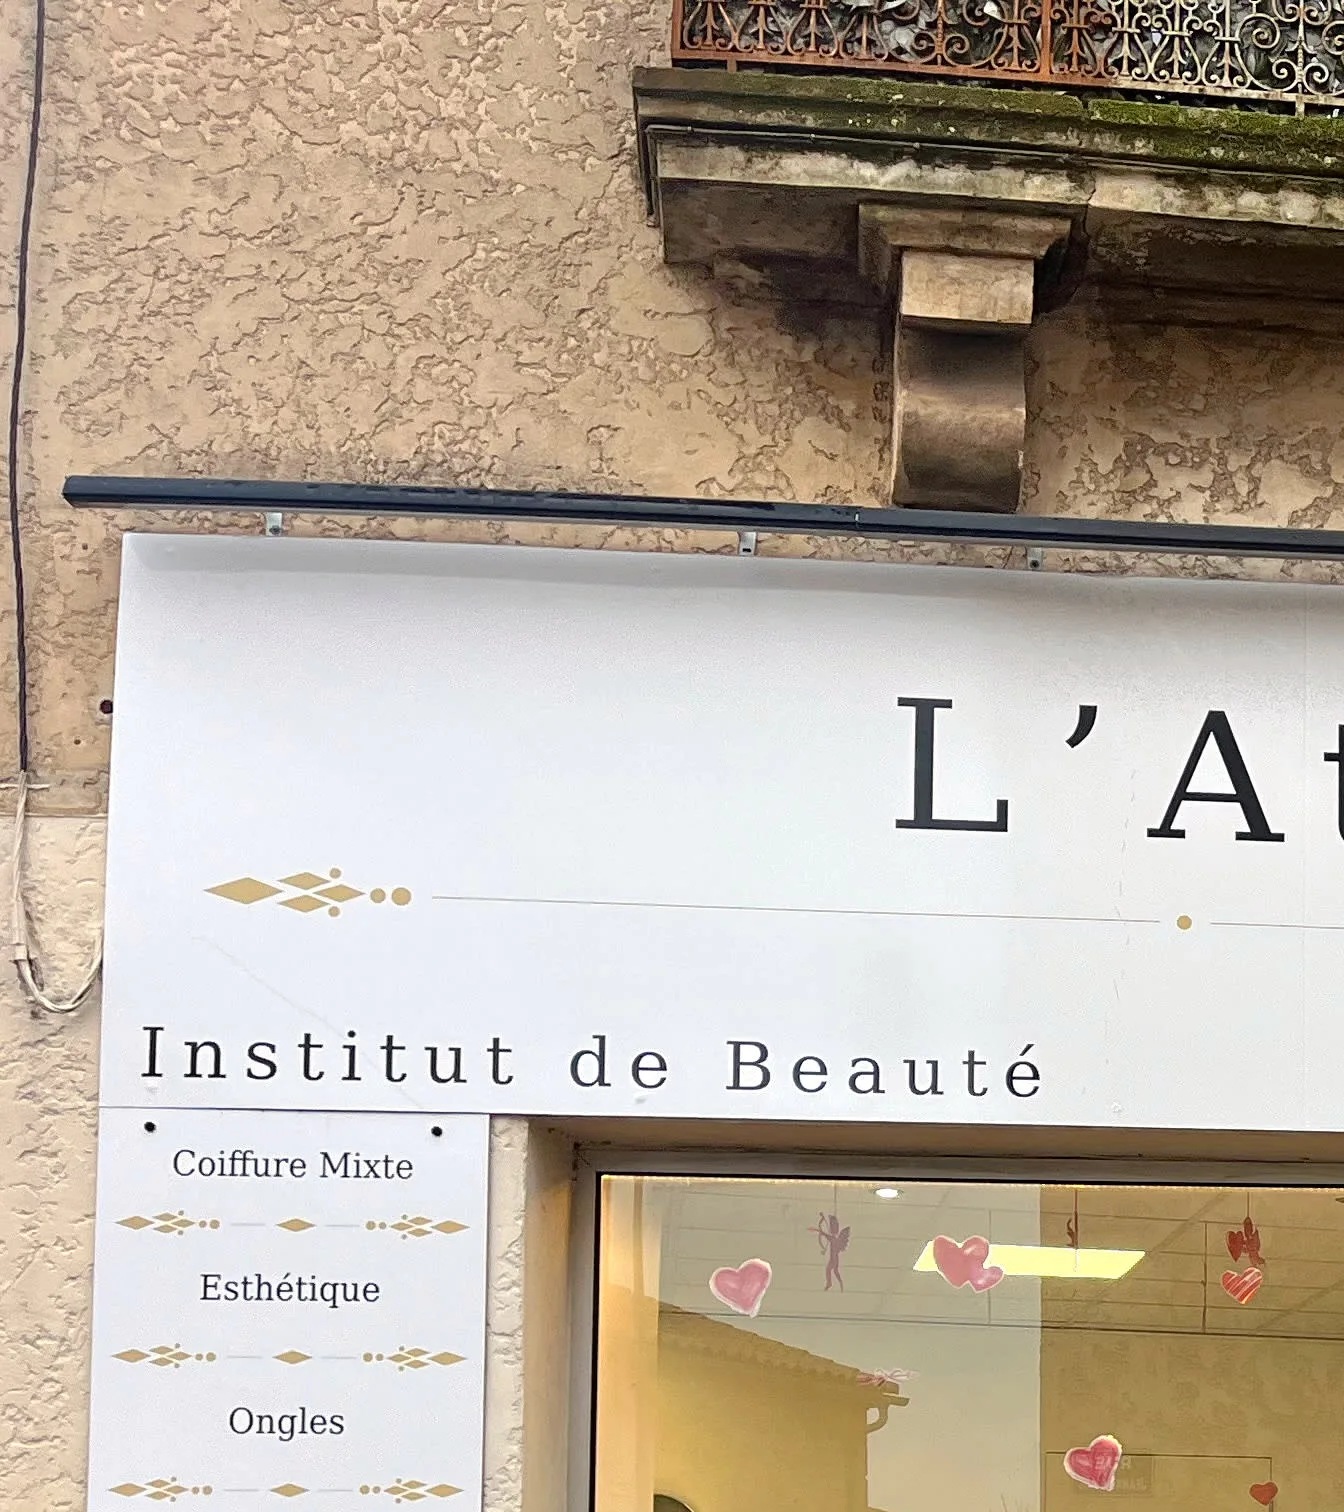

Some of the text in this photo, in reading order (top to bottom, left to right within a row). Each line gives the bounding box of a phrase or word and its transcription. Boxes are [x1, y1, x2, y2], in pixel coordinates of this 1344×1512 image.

[142, 1026, 1041, 1098] Institut de Beauté
[173, 1149, 413, 1180] Coiffure Mixte
[200, 1272, 380, 1308] Esthétique
[229, 1406, 345, 1442] Ongles
